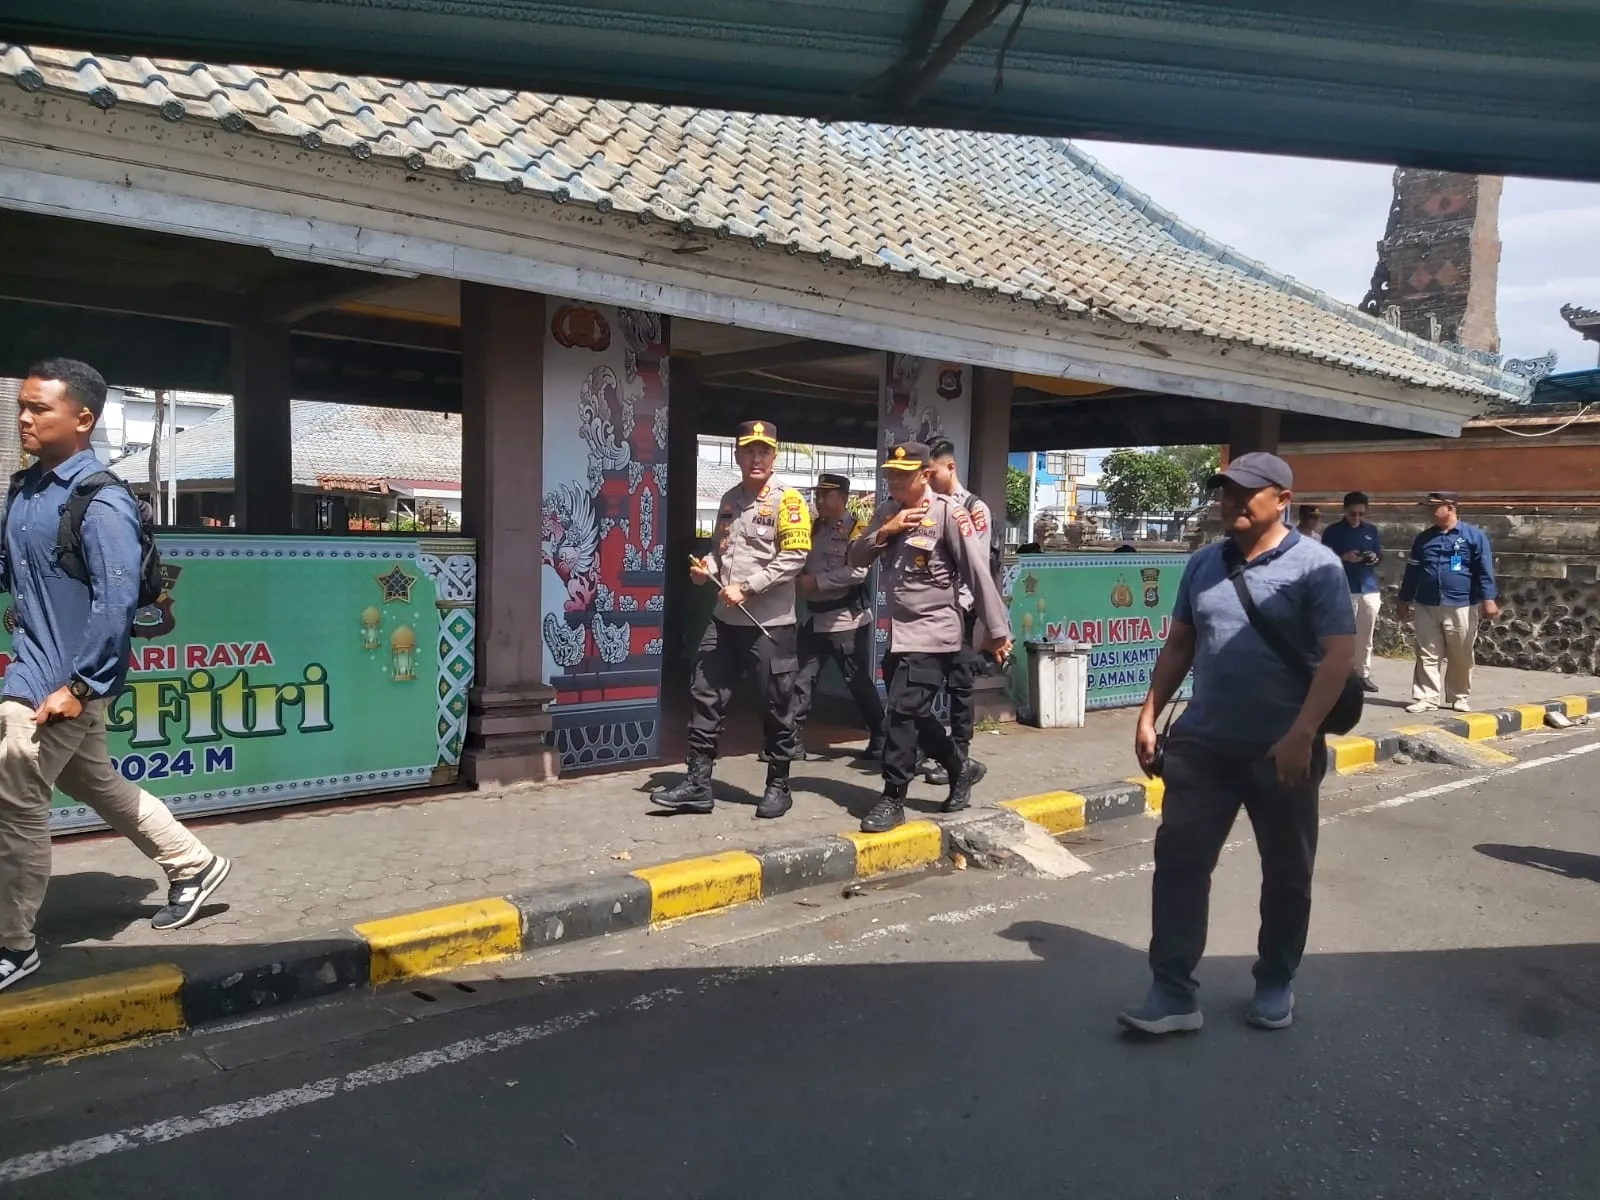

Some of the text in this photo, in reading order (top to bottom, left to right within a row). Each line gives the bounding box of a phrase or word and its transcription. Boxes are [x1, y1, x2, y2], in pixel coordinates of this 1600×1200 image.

[1108, 617, 1153, 643] KITA
[128, 643, 273, 671] ARI RAYA
[1099, 670, 1135, 687] AMAN
[1138, 669, 1146, 682] &
[124, 663, 333, 747] Fitri
[205, 746, 233, 773] M
